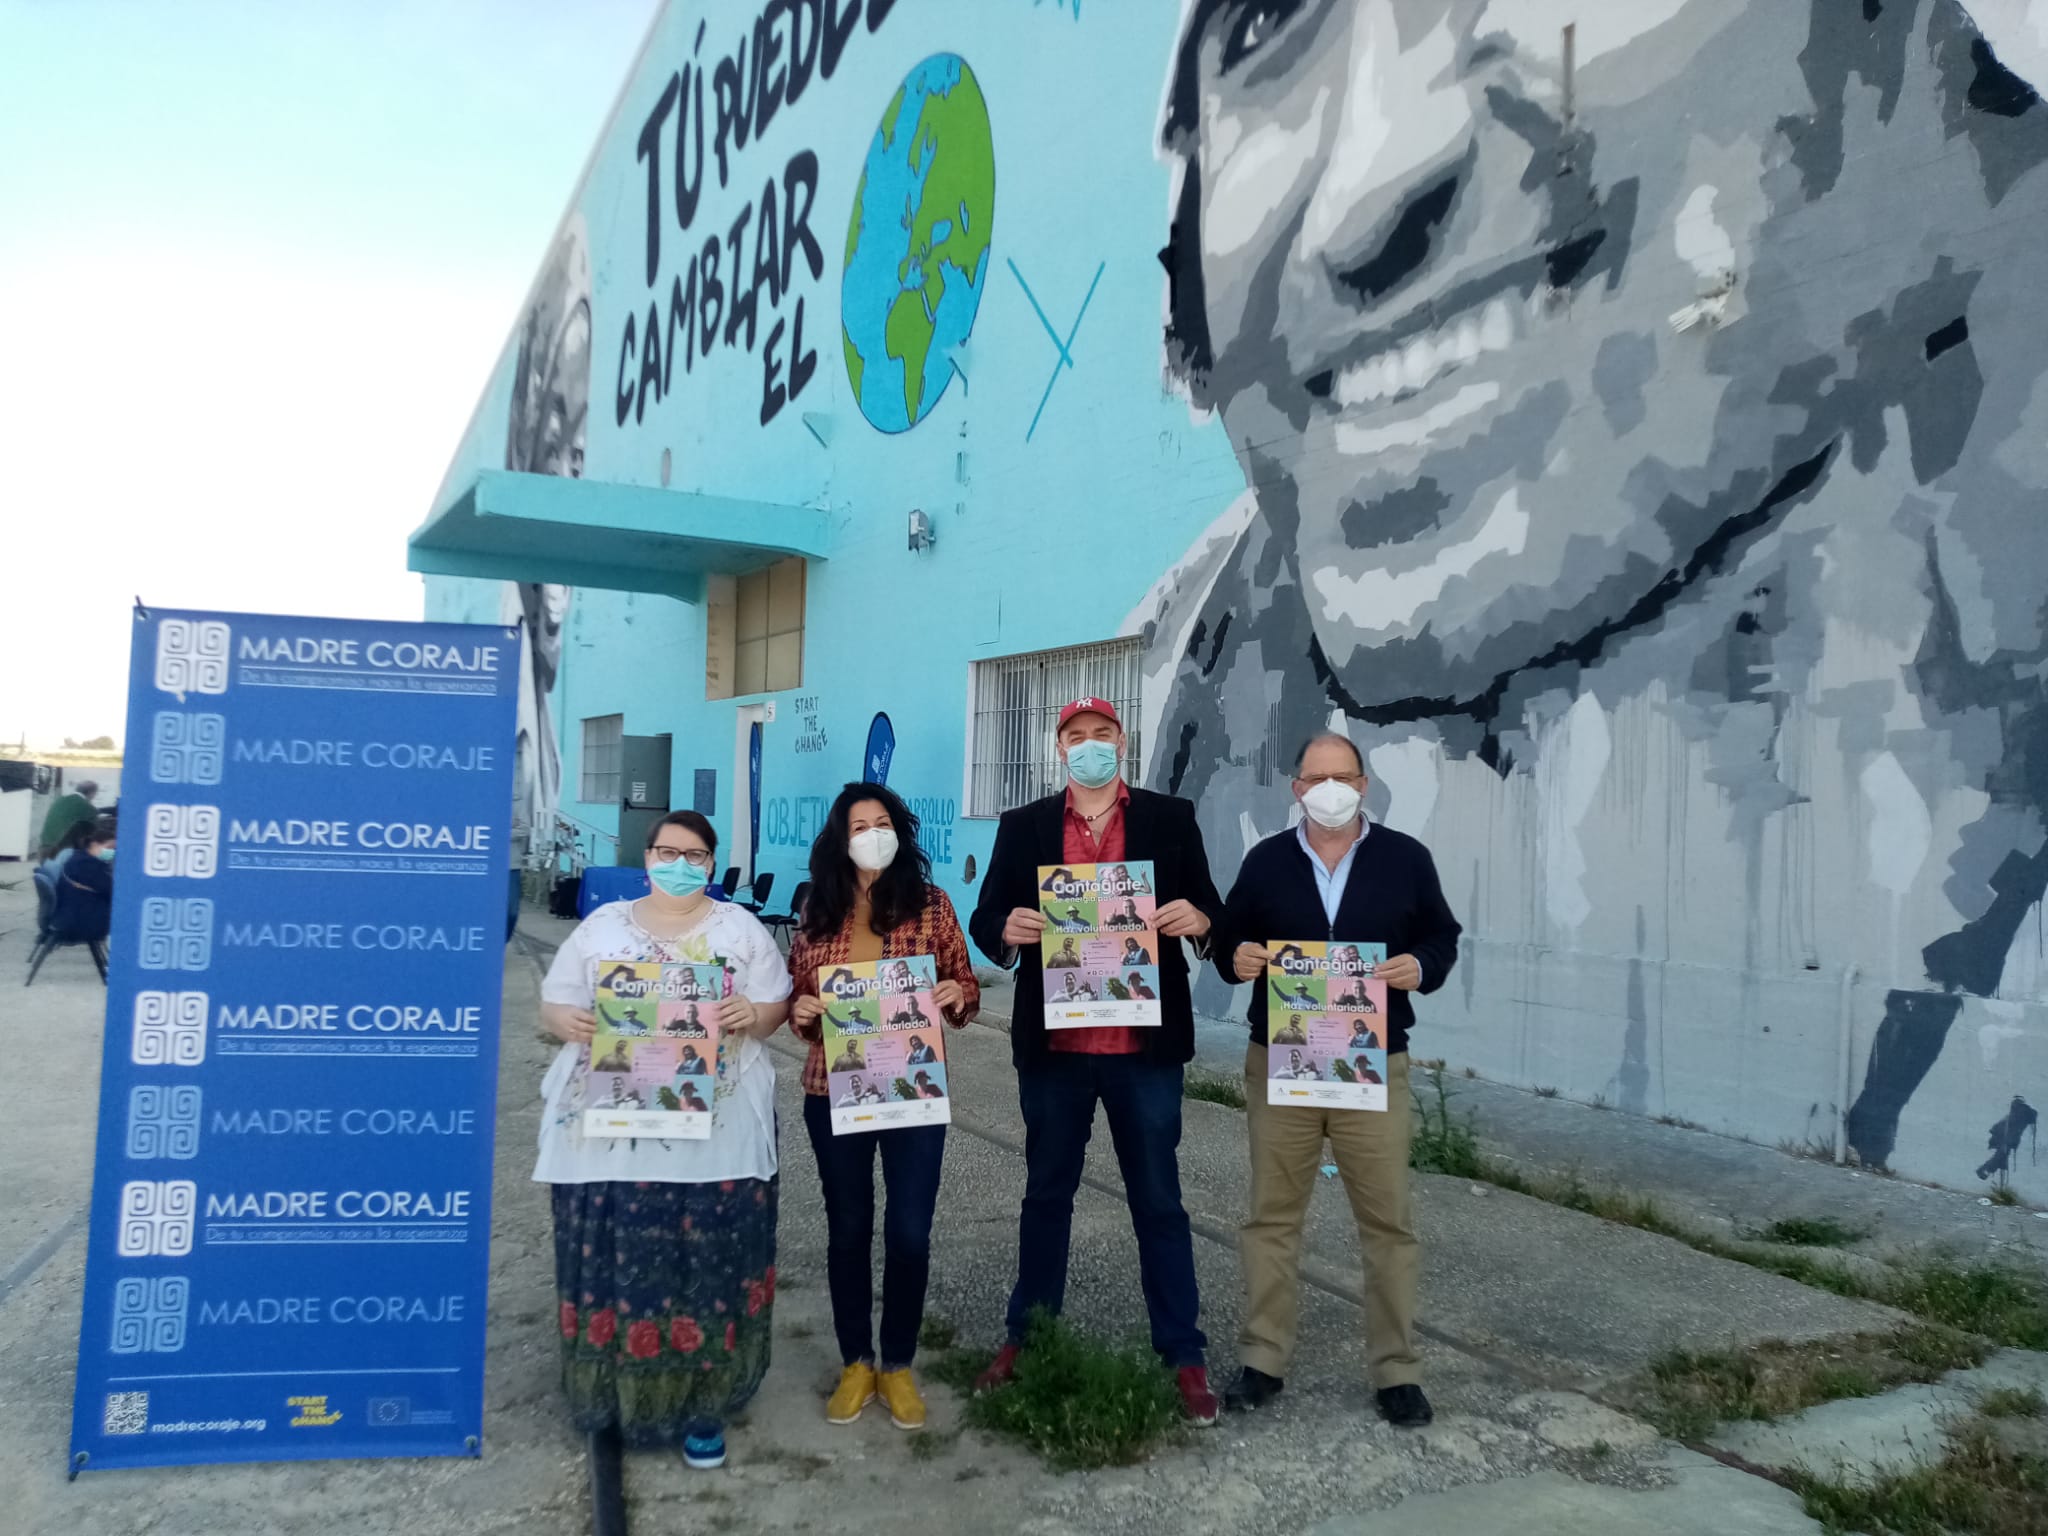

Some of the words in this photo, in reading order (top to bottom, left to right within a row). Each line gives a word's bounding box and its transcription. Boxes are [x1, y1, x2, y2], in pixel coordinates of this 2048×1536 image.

[637, 17, 706, 289] TÚ
[616, 149, 824, 427] CAMBIAR
[760, 296, 817, 426] EL
[239, 635, 360, 666] MADRE
[366, 640, 500, 672] CORAJE
[795, 696, 819, 714] START
[804, 715, 818, 732] THE
[795, 728, 828, 754] CHANGE
[232, 738, 353, 767] MADRE
[361, 741, 495, 772] CORAJE
[227, 818, 350, 848] MADRE
[357, 820, 491, 850] CORAJE
[230, 852, 249, 865] De
[254, 854, 266, 865] tu
[359, 860, 393, 869] nace
[399, 858, 412, 870] la
[415, 861, 488, 872] esperanza
[222, 922, 343, 950] MADRE
[352, 924, 485, 951] CORAJE
[1053, 924, 1078, 935] ¡Haz
[1078, 922, 1145, 933] voluntariado!
[217, 1004, 339, 1031] MADRE
[346, 1005, 481, 1032] CORAJE
[1280, 1001, 1303, 1012] ¡Haz
[1304, 1003, 1375, 1013] voluntariado!
[835, 1027, 861, 1039] ¡Haz
[861, 1019, 929, 1034] voluntariado!
[218, 1038, 239, 1052] De
[260, 1041, 345, 1054] compromiso
[350, 1042, 384, 1053] nace
[406, 1043, 477, 1056] esperanza
[211, 1108, 333, 1135] MADRE
[341, 1108, 474, 1135] CORAJE
[205, 1190, 328, 1218] MADRE
[335, 1190, 471, 1218] CORAJE
[206, 1227, 225, 1240] De
[394, 1229, 468, 1241] esperanza
[199, 1297, 321, 1324] MADRE
[330, 1295, 465, 1323] CORAJE
[152, 1417, 267, 1433] madrecoraje.org
